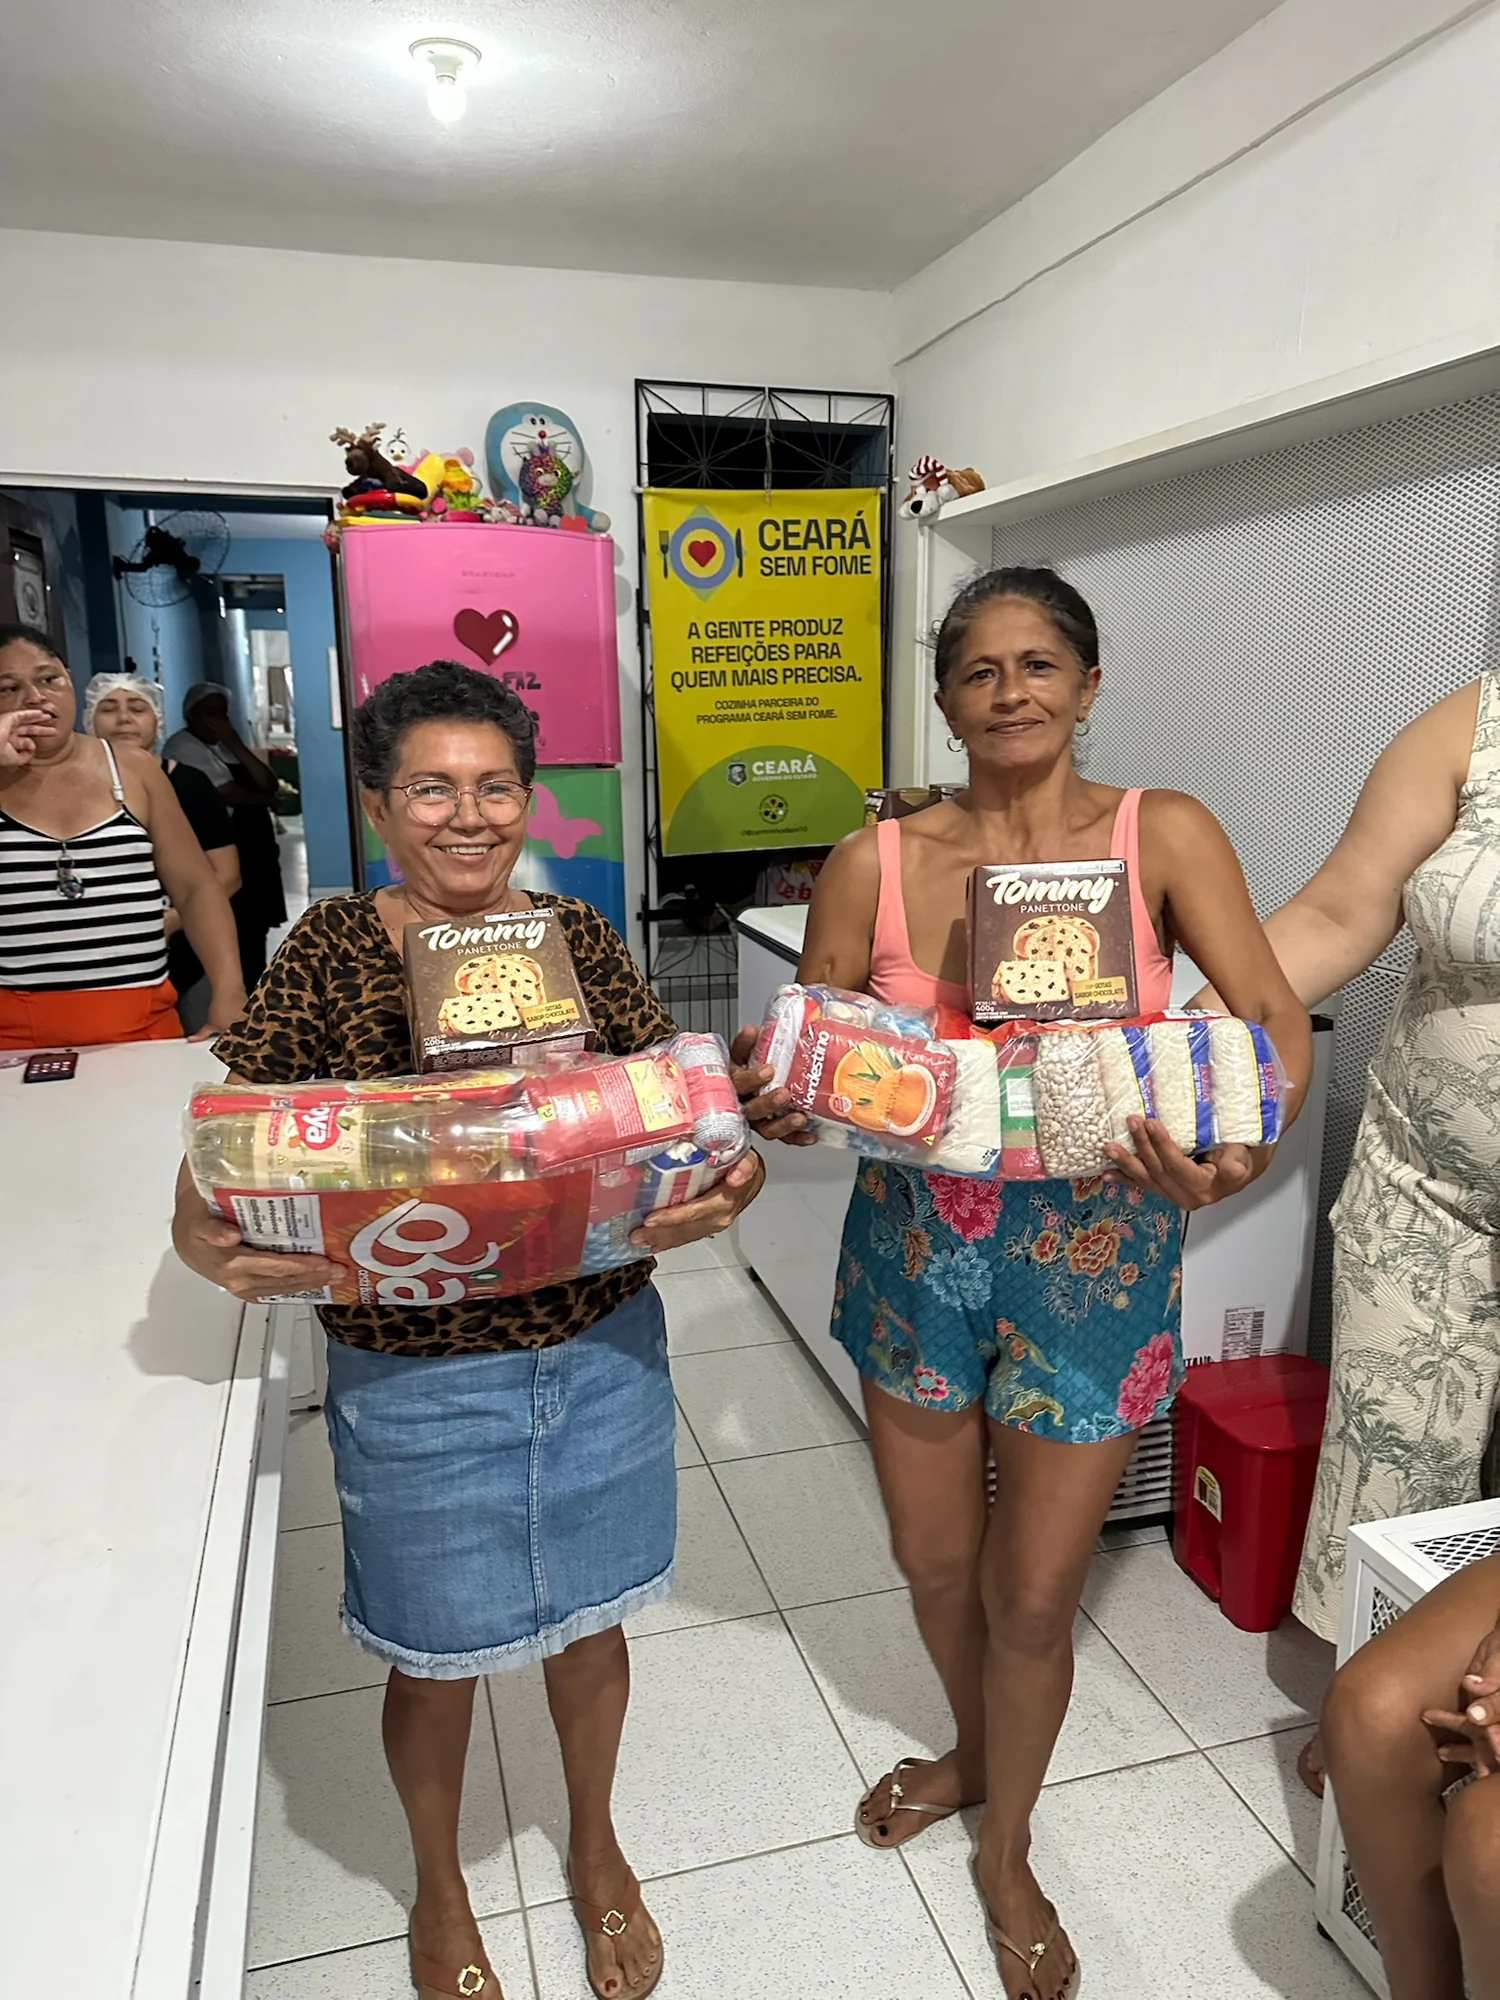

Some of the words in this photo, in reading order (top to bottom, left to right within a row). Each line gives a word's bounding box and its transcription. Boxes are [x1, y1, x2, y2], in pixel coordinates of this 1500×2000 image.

[758, 510, 871, 551] CEARÁ
[760, 556, 806, 577] SEM
[812, 555, 872, 576] FOME
[688, 622, 701, 639] A
[704, 620, 765, 639] GENTE
[769, 618, 843, 637] PRODUZ
[692, 640, 789, 666] REFEIÇÕES
[795, 643, 842, 660] PARA
[671, 669, 727, 692] QUEM
[732, 668, 778, 687] MAIS
[783, 665, 862, 685] PRECISA.
[715, 699, 757, 710] COZINHA
[758, 697, 804, 709] PARCEIRA
[805, 697, 819, 706] DO
[697, 711, 751, 724] PROGRAMA
[753, 709, 785, 722] CEARÁ
[786, 710, 807, 720] SEM
[808, 708, 838, 720] FOME.
[752, 754, 817, 775] CEARÁ
[986, 872, 1114, 914] Tommy
[1021, 902, 1085, 914] PANETTONE
[418, 920, 546, 952] Tommy
[457, 941, 523, 956] PANETTONE
[1093, 987, 1125, 997] CHOCOLATE
[545, 1008, 577, 1020] CHOCOLATE
[976, 1005, 995, 1013] 400g
[801, 1031, 830, 1111] Nordestino
[301, 1107, 331, 1144] oya
